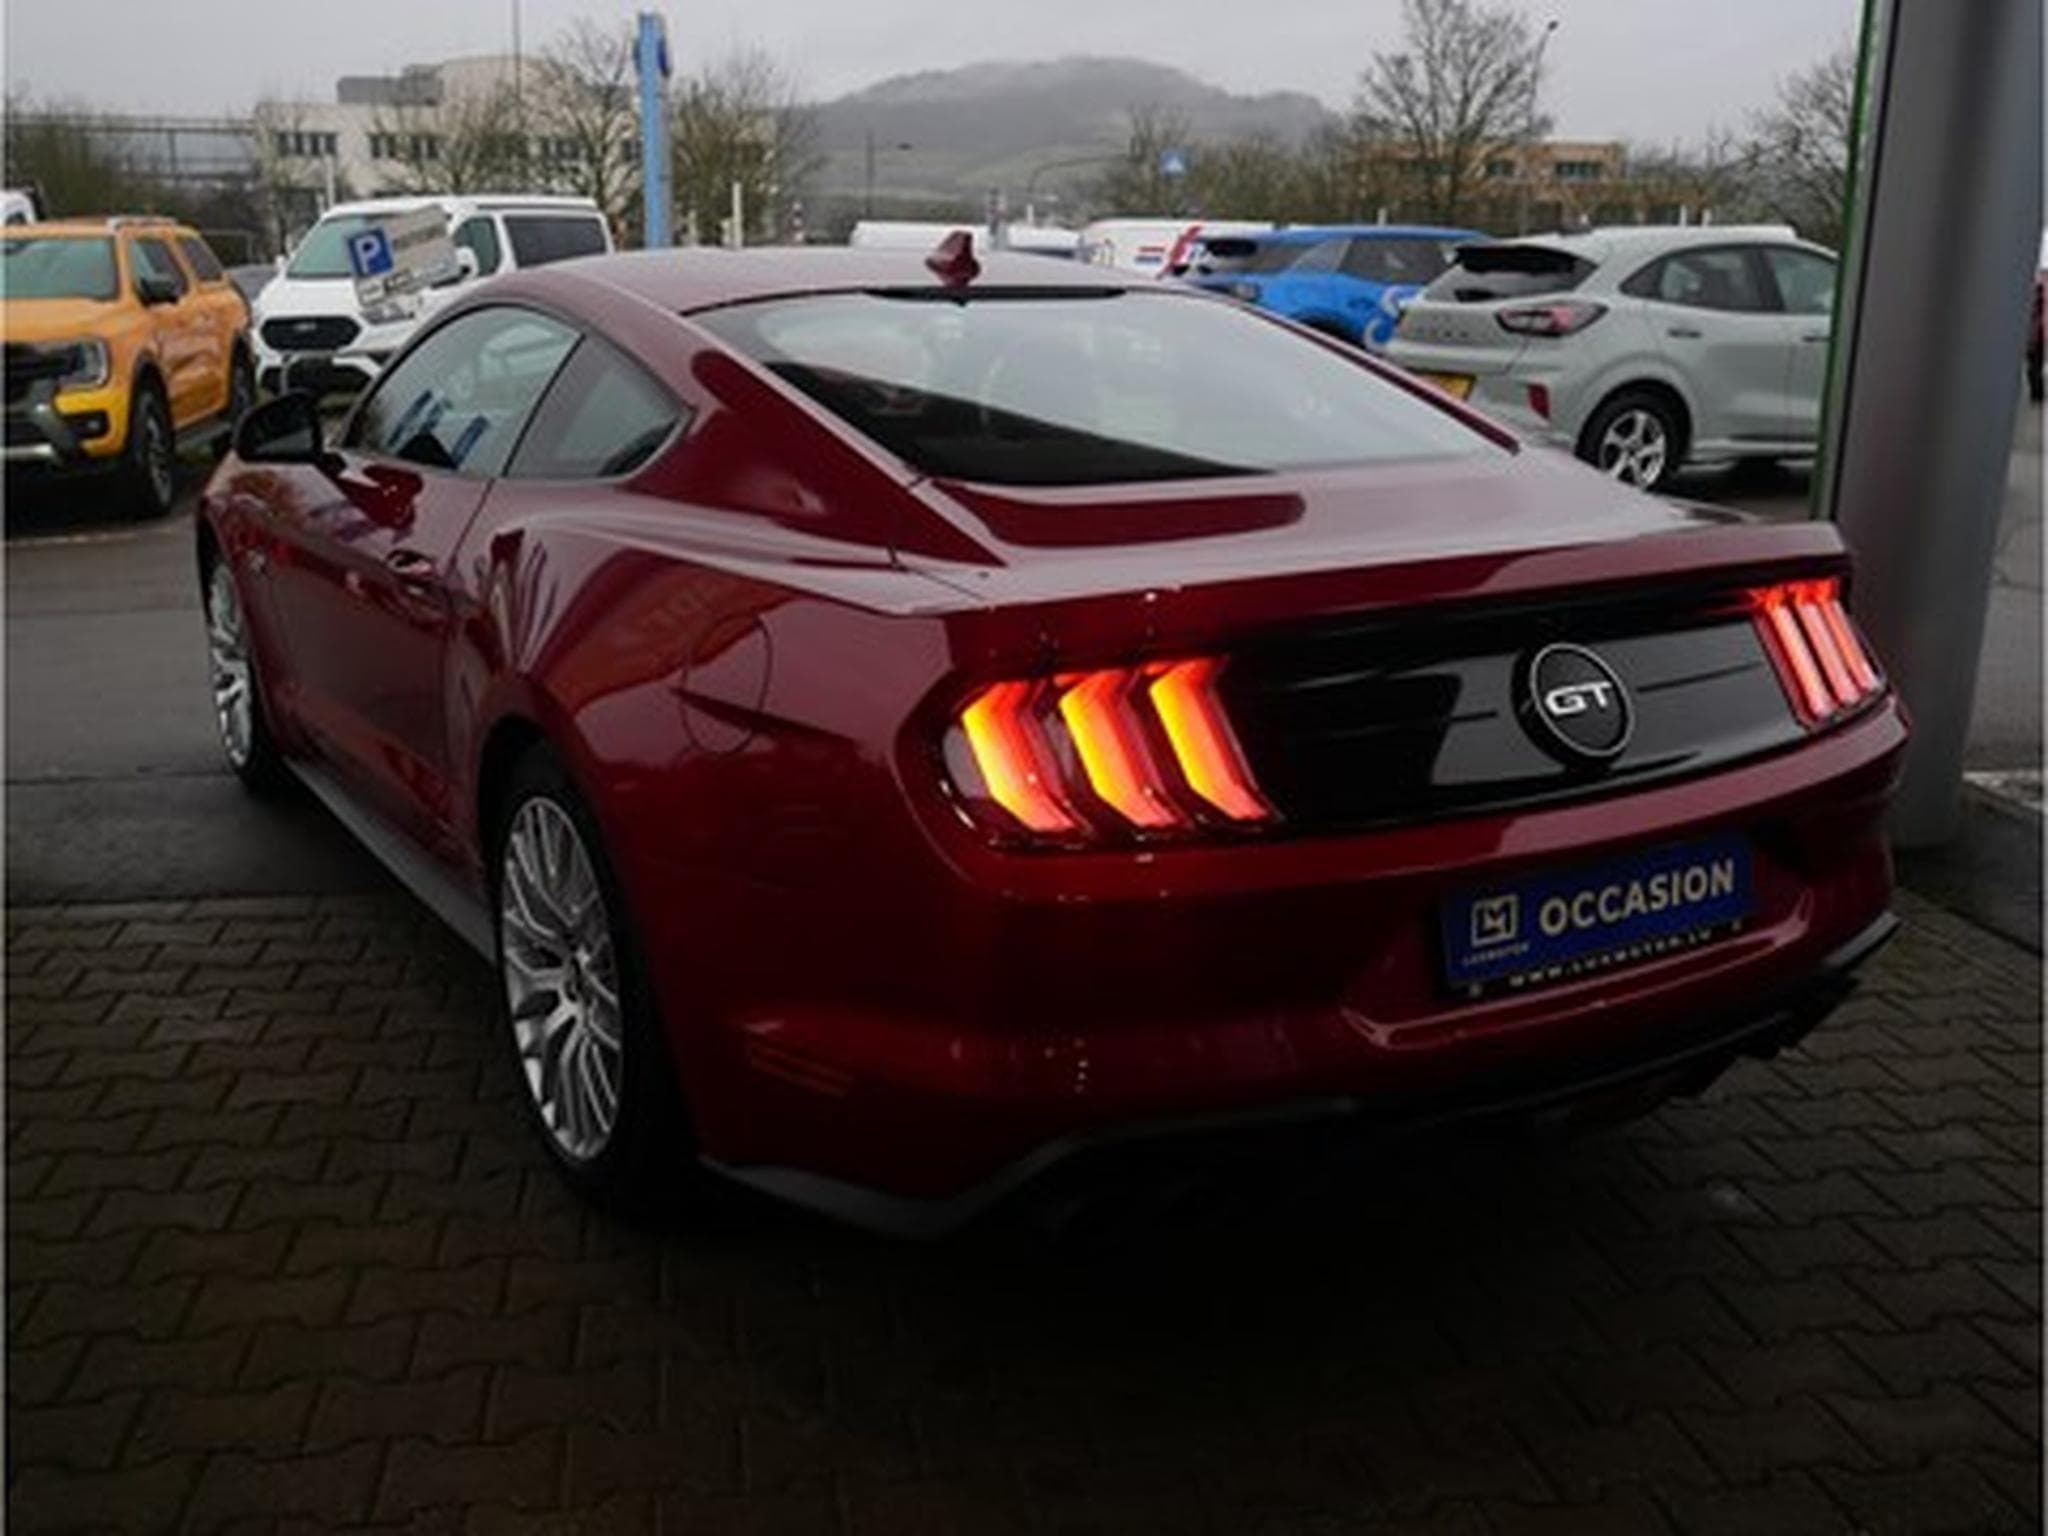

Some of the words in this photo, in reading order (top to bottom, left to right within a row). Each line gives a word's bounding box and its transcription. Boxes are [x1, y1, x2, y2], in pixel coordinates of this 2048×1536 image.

[355, 235, 380, 274] P
[1546, 681, 1612, 716] GT
[1539, 859, 1735, 936] OCCASION
